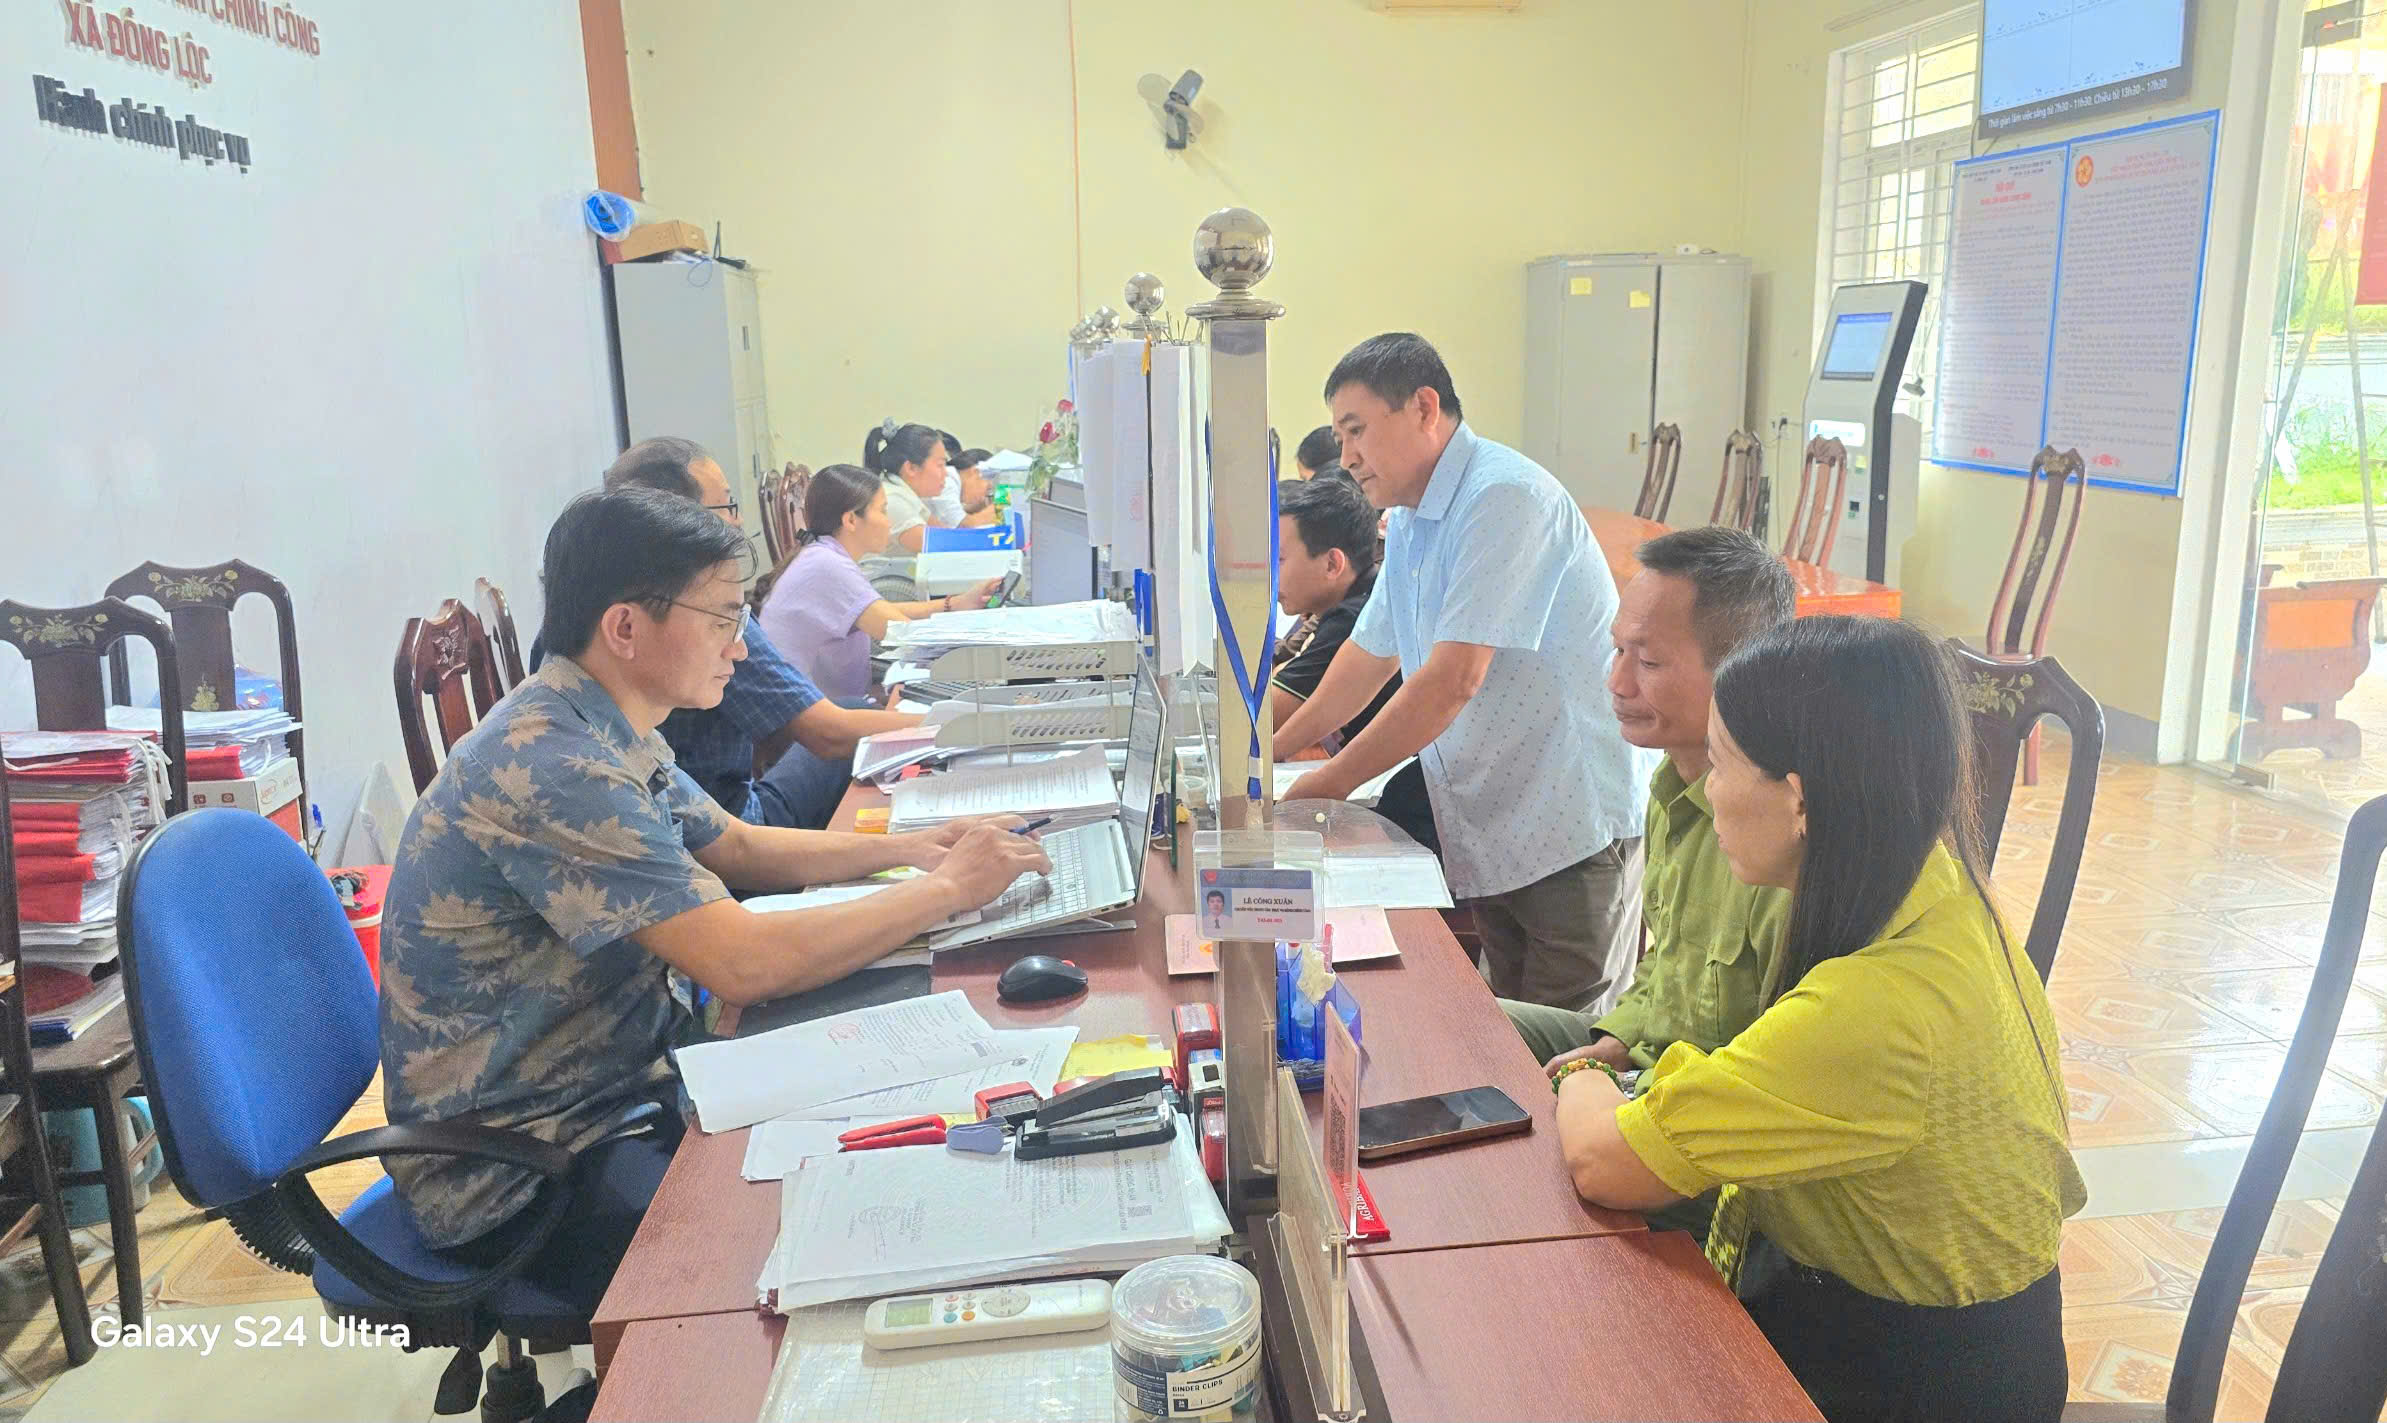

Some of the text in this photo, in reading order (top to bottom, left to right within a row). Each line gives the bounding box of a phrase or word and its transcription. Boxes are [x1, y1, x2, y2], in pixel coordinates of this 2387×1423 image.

[272, 2, 320, 56] CÔNG
[104, 7, 170, 70] ĐỒNG
[174, 32, 213, 89] LỘC
[2121, 84, 2141, 97] 13h30
[109, 97, 177, 149] chính
[175, 114, 226, 166] phục
[223, 132, 252, 174] vụ
[1253, 897, 1273, 905] CÔNG
[1274, 897, 1293, 905] XUÂN
[1202, 1379, 1223, 1390] CLIPS
